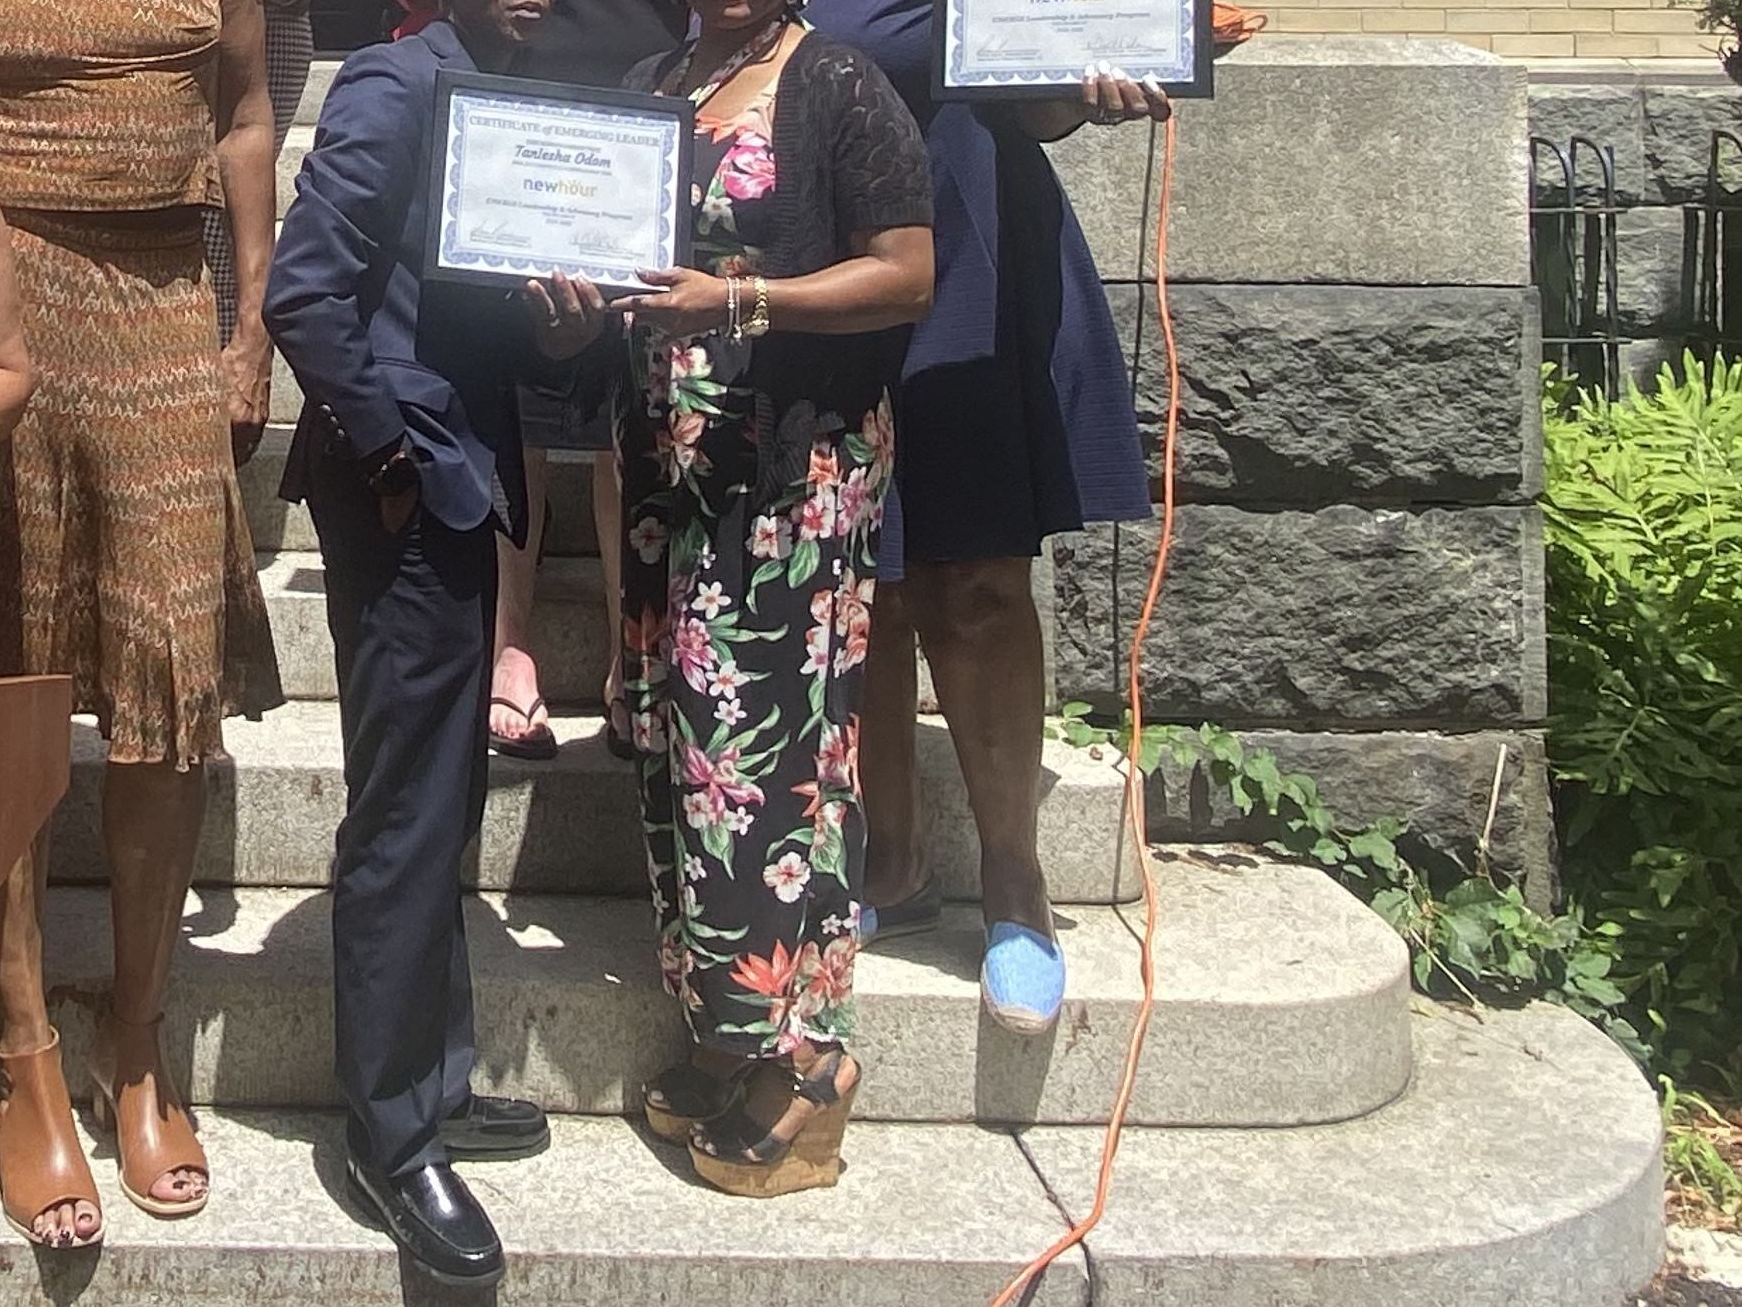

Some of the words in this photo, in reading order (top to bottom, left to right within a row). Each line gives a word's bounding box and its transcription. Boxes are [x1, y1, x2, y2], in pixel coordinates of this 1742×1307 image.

[469, 115, 540, 134] CERTIFICATE
[541, 124, 555, 136] of
[553, 126, 614, 142] EMERGING
[615, 133, 660, 146] LEADER
[574, 151, 611, 169] Odom
[522, 178, 597, 197] newhour
